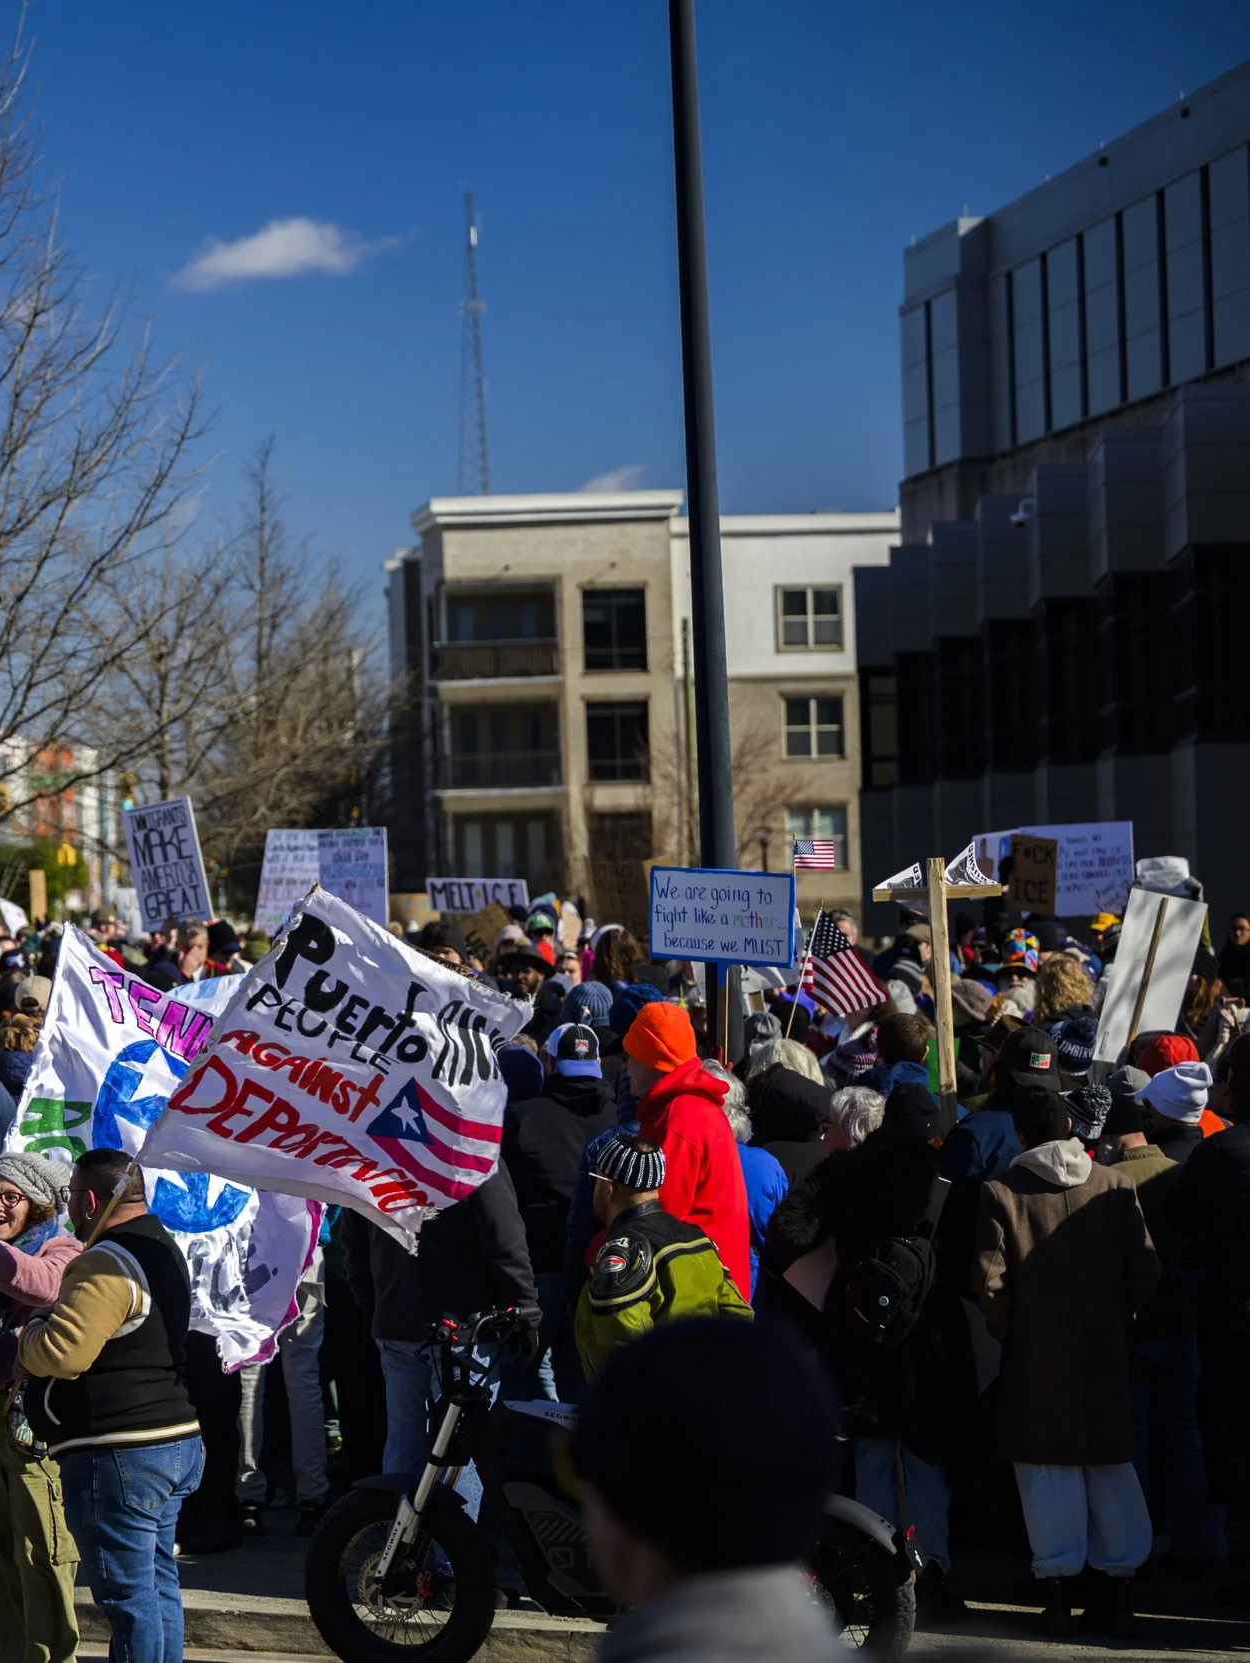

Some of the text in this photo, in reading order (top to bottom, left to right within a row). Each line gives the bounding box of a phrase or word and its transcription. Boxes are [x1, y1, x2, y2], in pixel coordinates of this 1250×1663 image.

[131, 823, 193, 868] MAKE
[140, 860, 199, 893] AMERICA
[654, 876, 773, 912] We are going to
[1013, 878, 1048, 905] ICE
[144, 884, 200, 920] GREAT
[430, 882, 475, 911] MELT
[654, 904, 688, 933] fight
[694, 906, 716, 925] like
[720, 916, 729, 926] a
[664, 932, 784, 956] because we MUST
[245, 984, 401, 1076] PEOPLE
[168, 1055, 435, 1213] DEPORTATIO
[382, 1527, 399, 1562] SEGWAY
